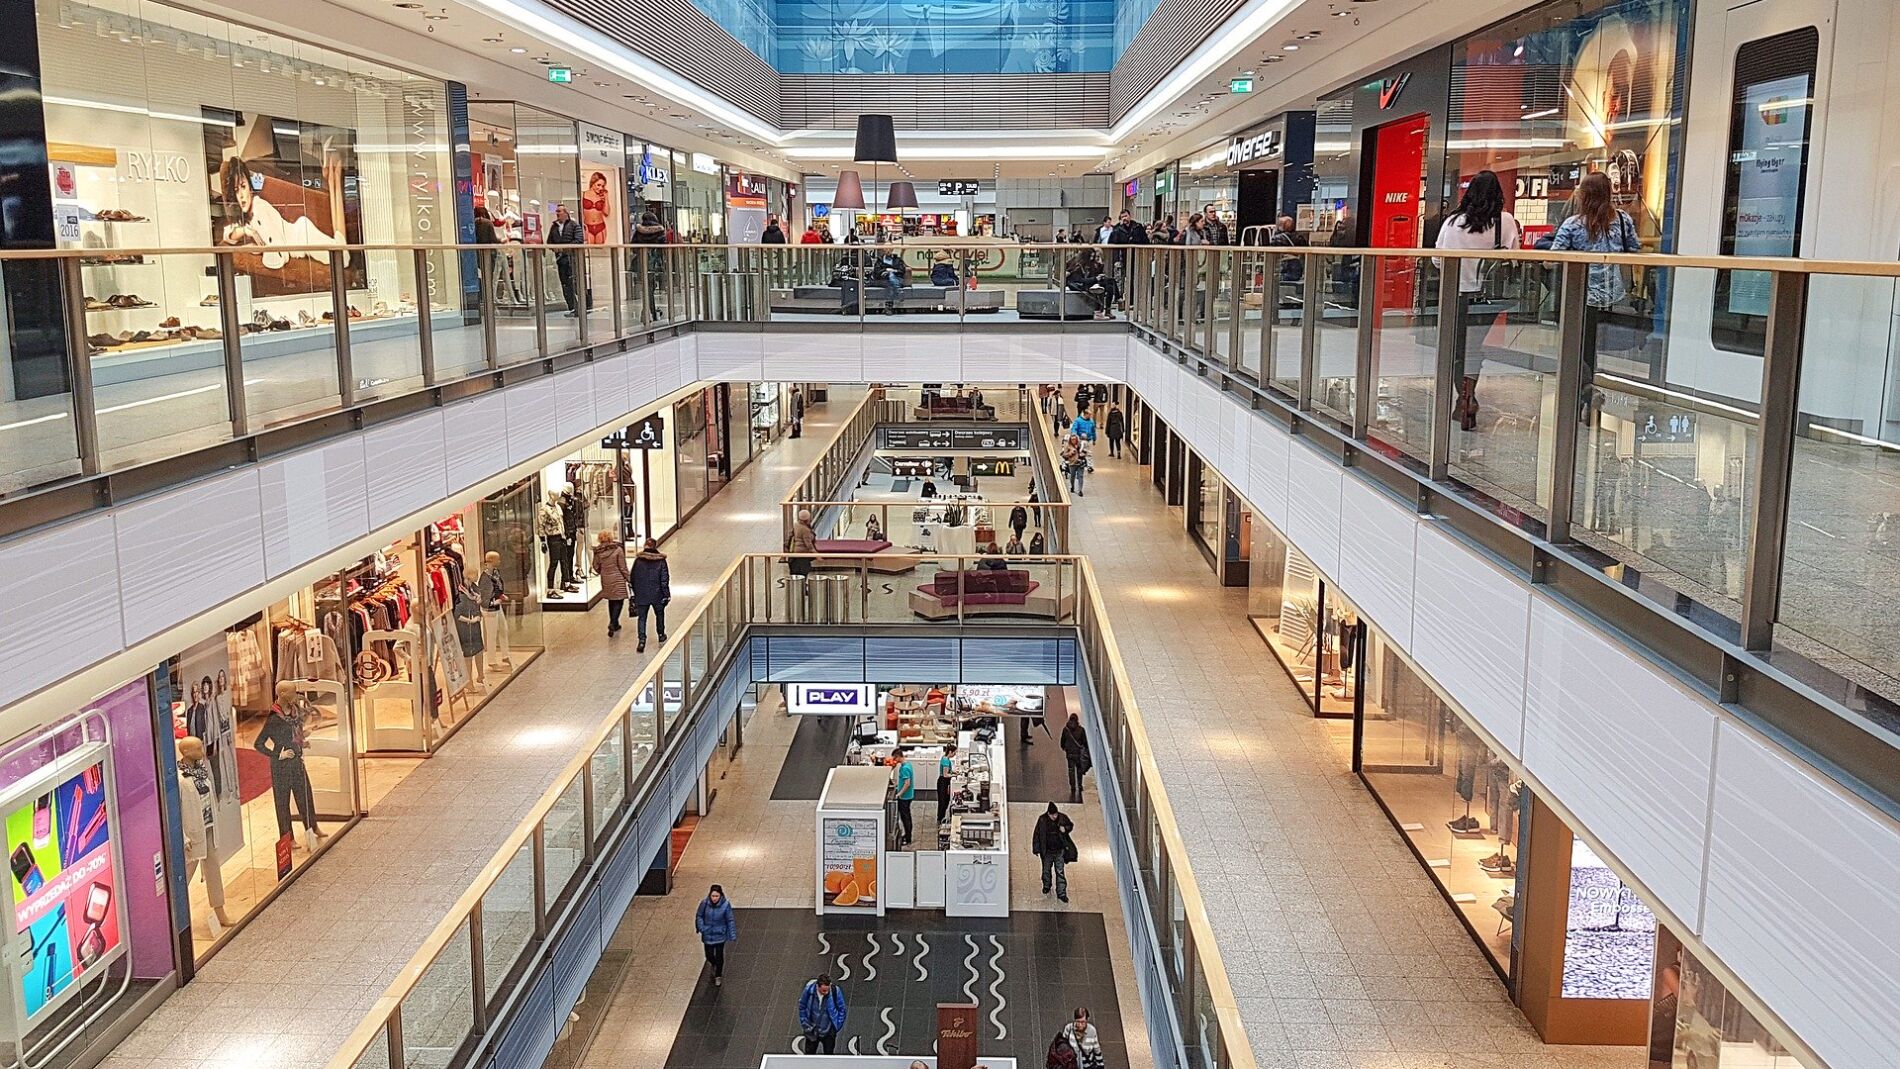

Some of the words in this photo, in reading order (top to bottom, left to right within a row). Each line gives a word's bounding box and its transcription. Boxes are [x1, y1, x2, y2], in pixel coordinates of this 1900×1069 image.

[1226, 131, 1273, 167] diverse
[127, 151, 190, 183] RYŁKO
[645, 165, 668, 183] KLEX
[955, 182, 963, 191] P
[1385, 192, 1408, 203] NIKE
[60, 223, 79, 237] 2016
[809, 691, 855, 703] PLAY
[1575, 887, 1624, 900] NOWY
[940, 1029, 973, 1038] Tchibo
